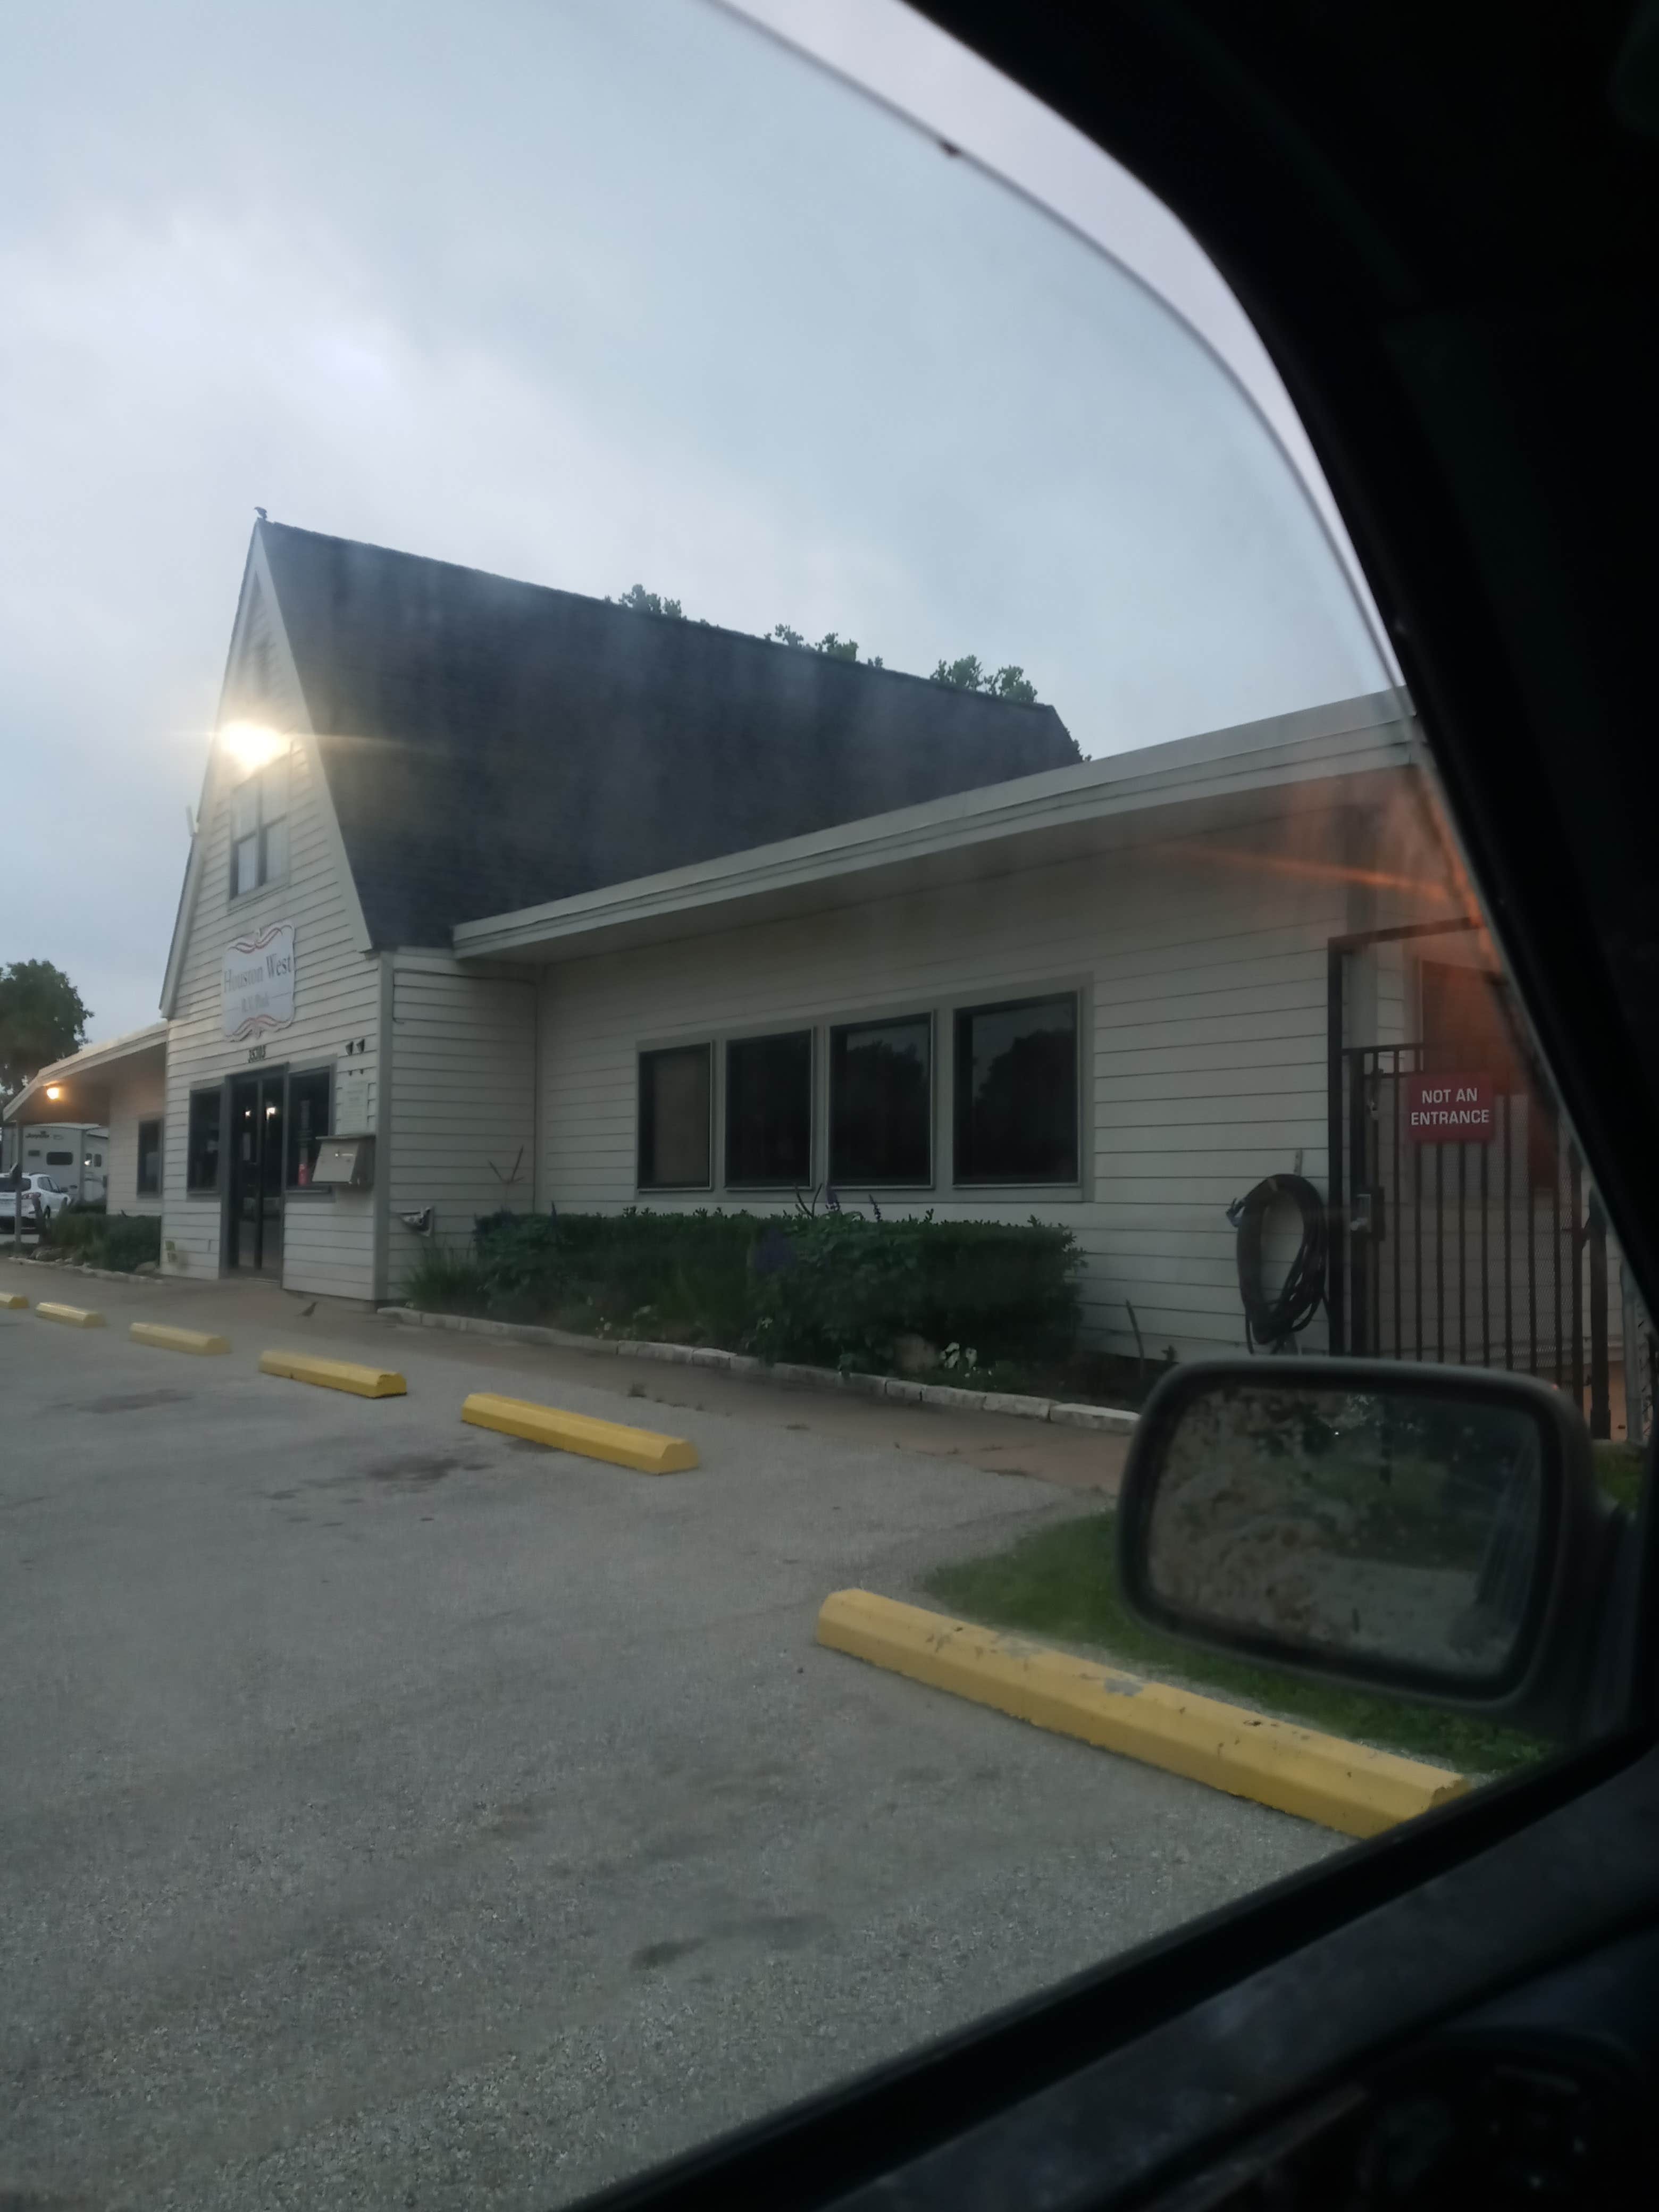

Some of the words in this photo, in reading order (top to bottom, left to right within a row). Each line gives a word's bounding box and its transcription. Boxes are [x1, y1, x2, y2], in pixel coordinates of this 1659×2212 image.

[266, 953, 291, 978] West
[1422, 1090, 1451, 1104] NOT
[1456, 1088, 1477, 1102] AN
[1411, 1109, 1489, 1126] ENTRANCE
